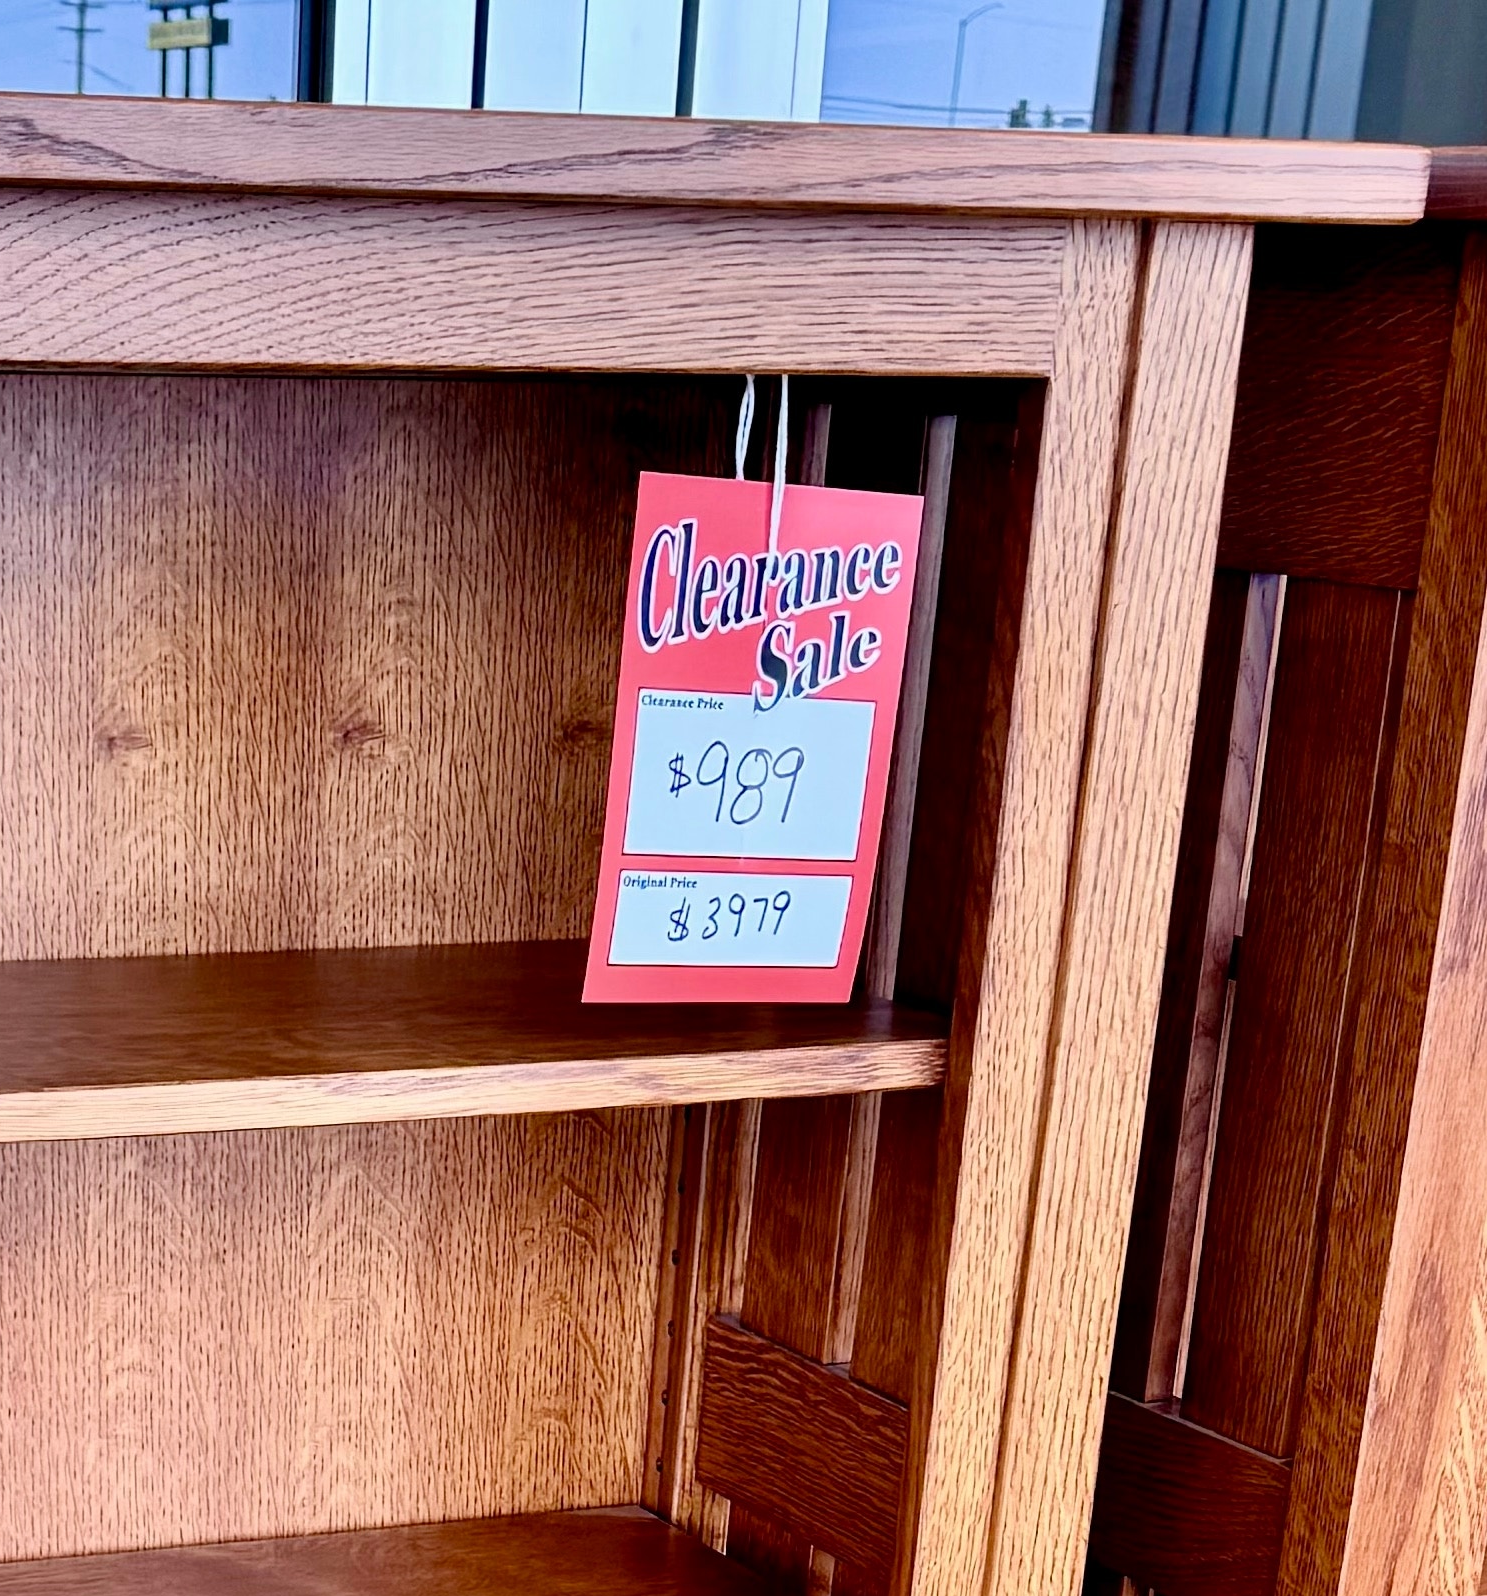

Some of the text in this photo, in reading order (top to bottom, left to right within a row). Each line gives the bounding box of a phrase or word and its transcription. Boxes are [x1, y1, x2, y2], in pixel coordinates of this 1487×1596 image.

[639, 519, 902, 652] Clearance
[641, 694, 724, 710] Clearance Price
[753, 612, 880, 713] Sale
[668, 740, 804, 825] $989
[623, 875, 698, 890] Original Price
